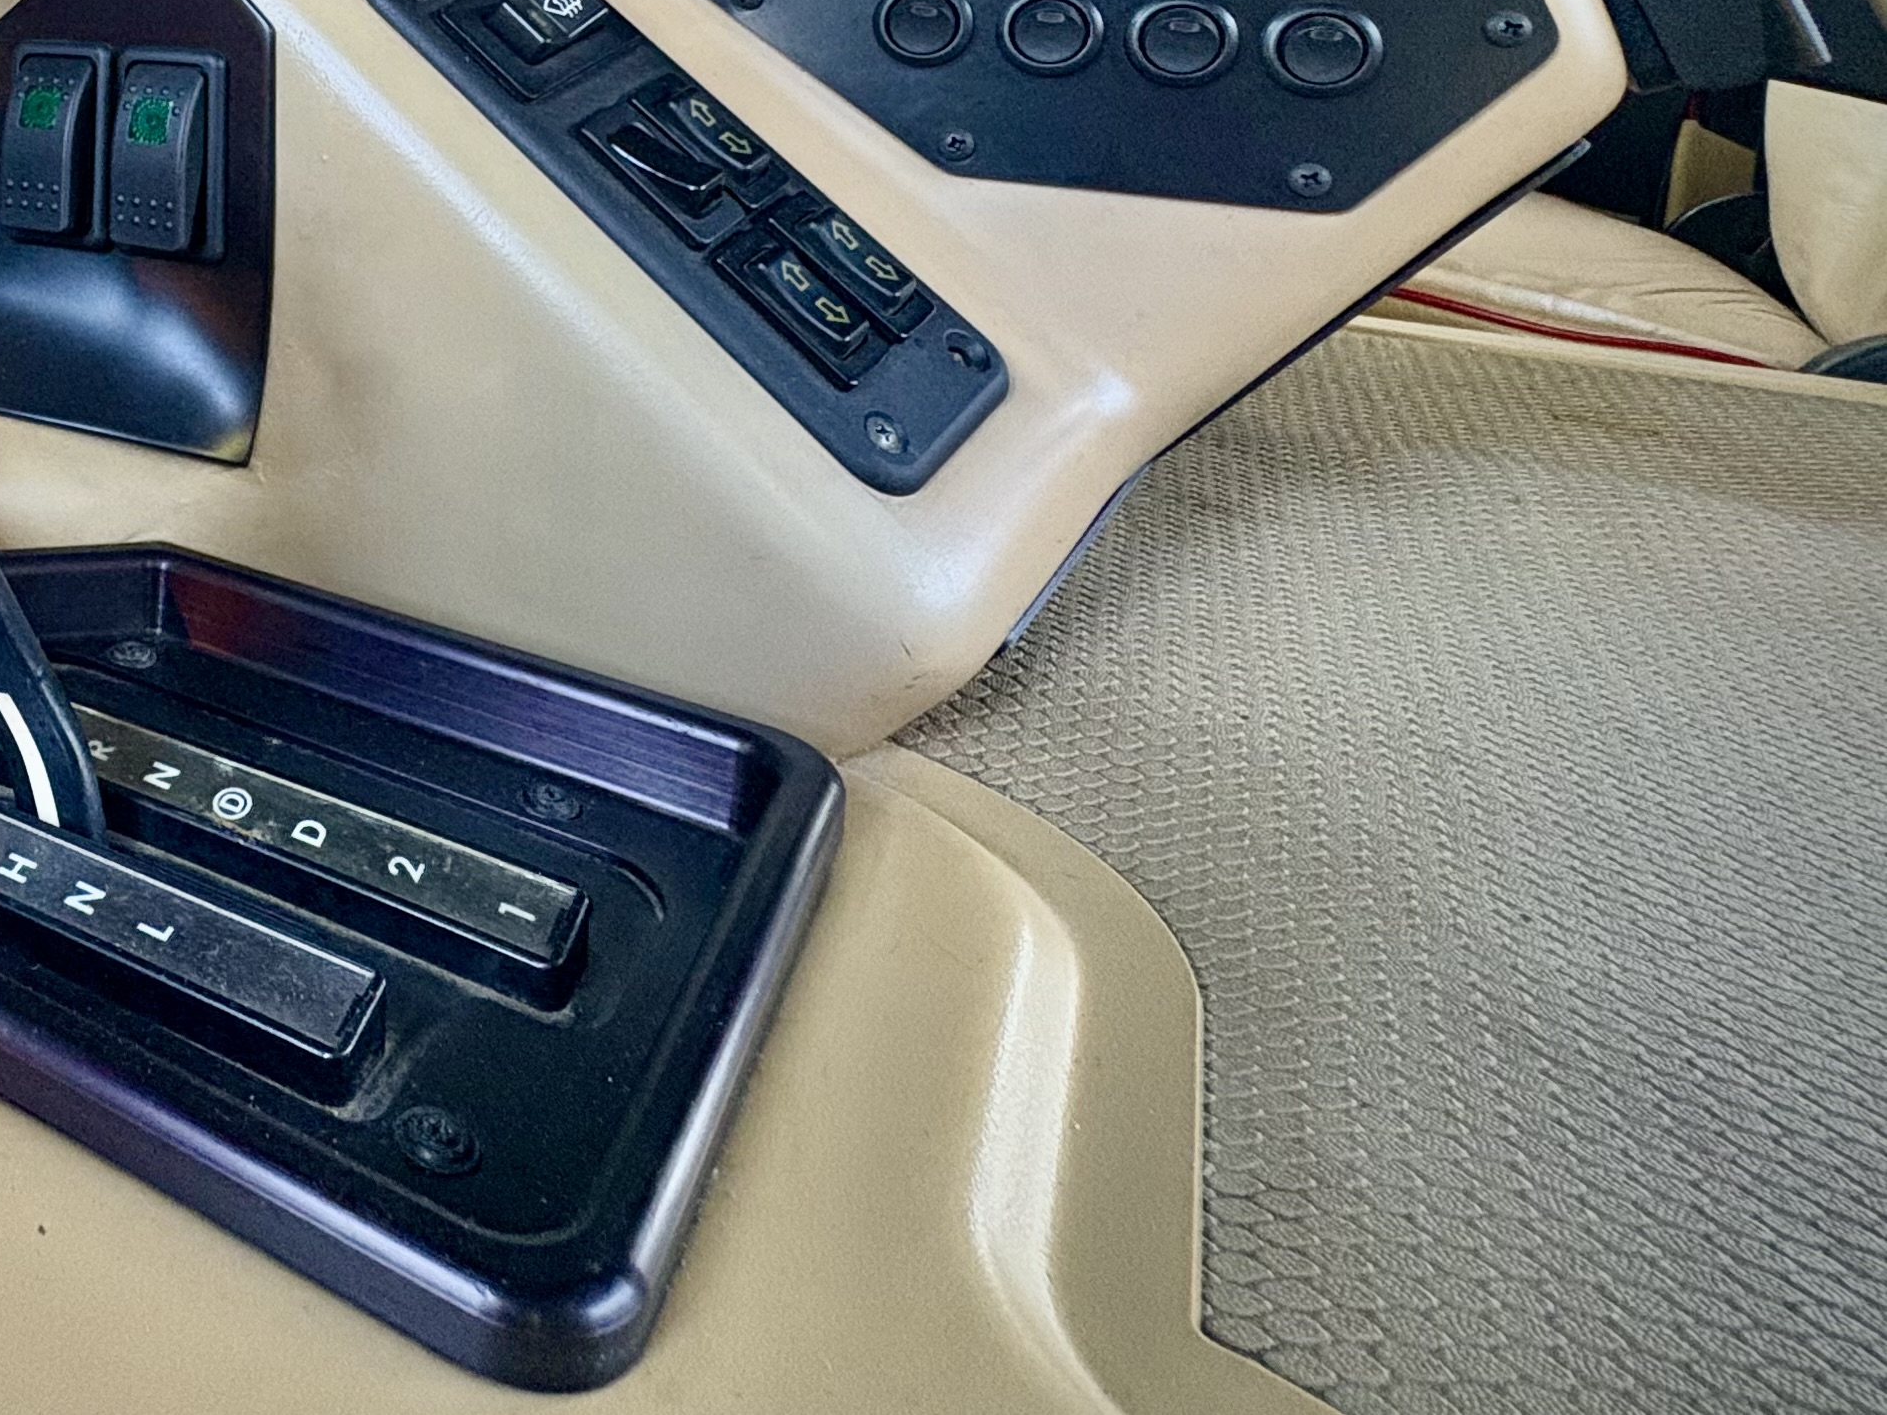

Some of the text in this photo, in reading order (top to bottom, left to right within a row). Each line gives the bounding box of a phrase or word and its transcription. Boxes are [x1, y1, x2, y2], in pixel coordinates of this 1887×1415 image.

[143, 761, 182, 790] N
[292, 819, 328, 847] D
[387, 854, 427, 883] 2
[63, 880, 108, 916] N
[498, 900, 538, 923] 1
[136, 920, 176, 943] L
